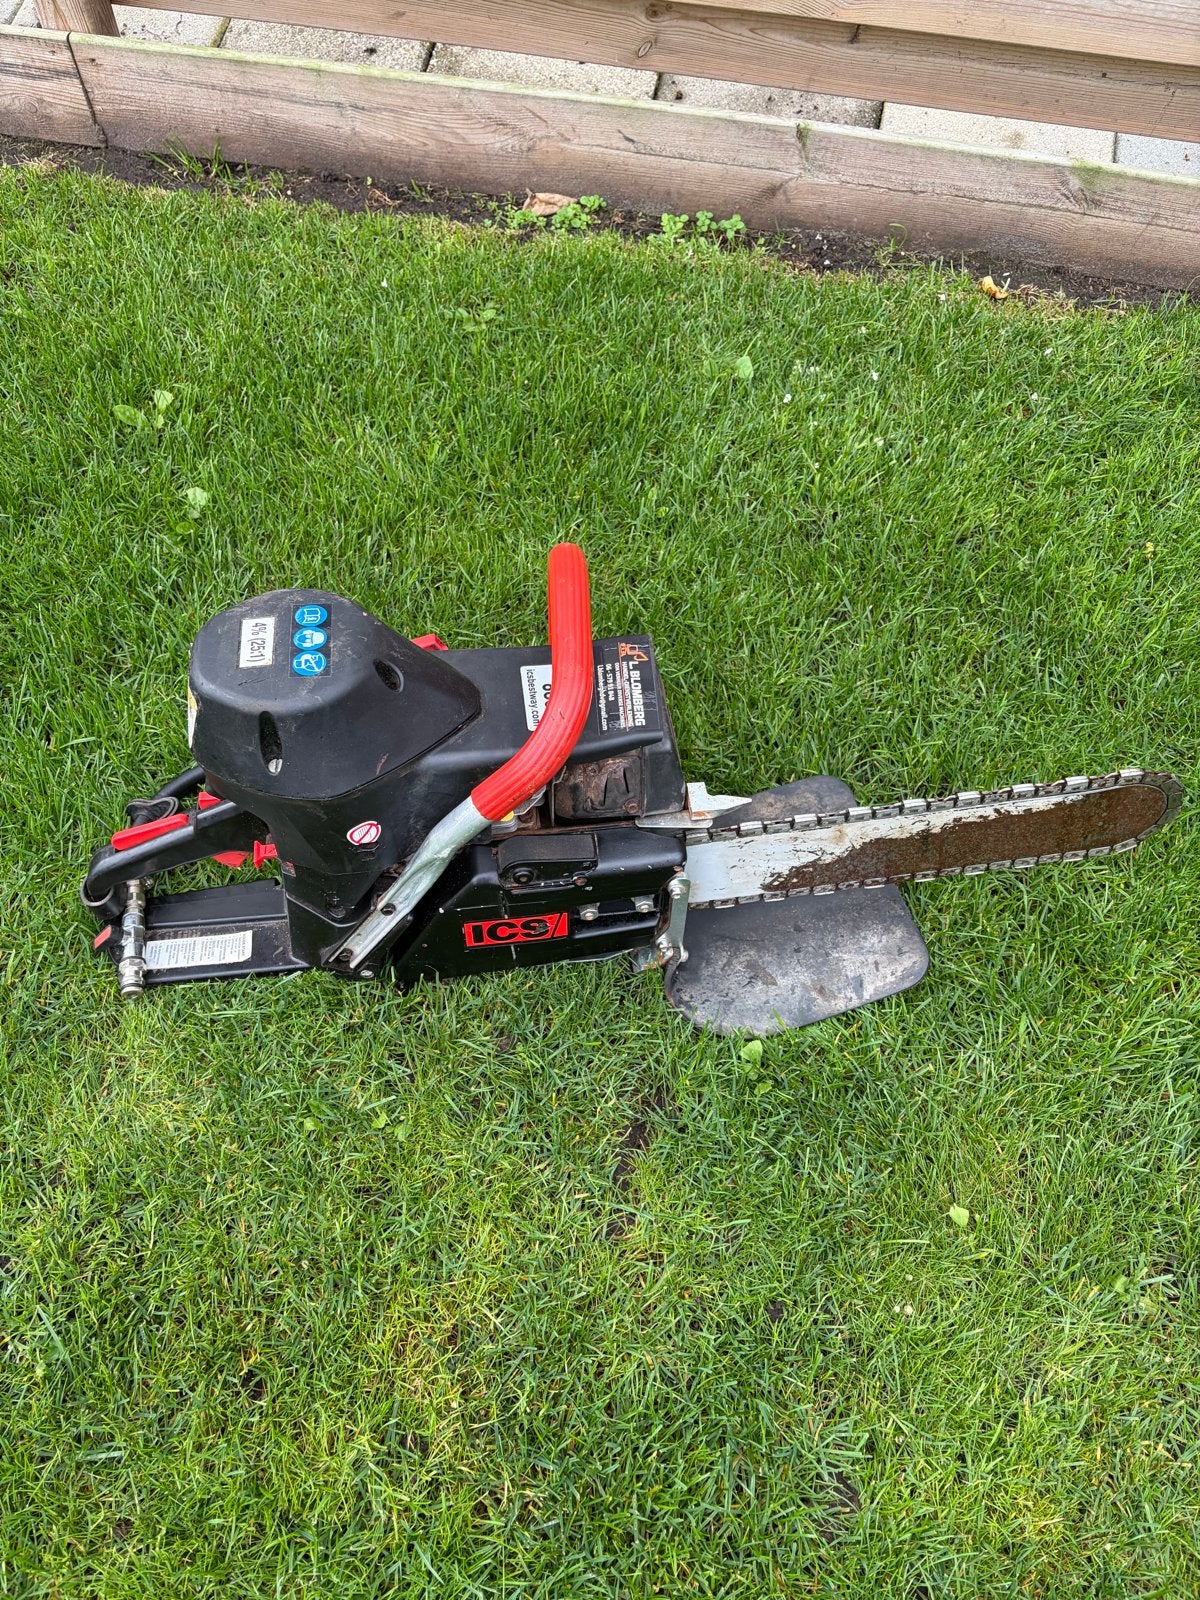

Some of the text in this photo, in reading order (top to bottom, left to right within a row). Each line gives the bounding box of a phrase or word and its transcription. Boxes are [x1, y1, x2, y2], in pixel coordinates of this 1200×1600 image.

[246, 622, 267, 663] 4% (25:1)
[605, 663, 612, 671] 06
[526, 669, 540, 727] icsbestway.com
[630, 670, 646, 726] BLOMBERG
[472, 918, 551, 944] ICS
